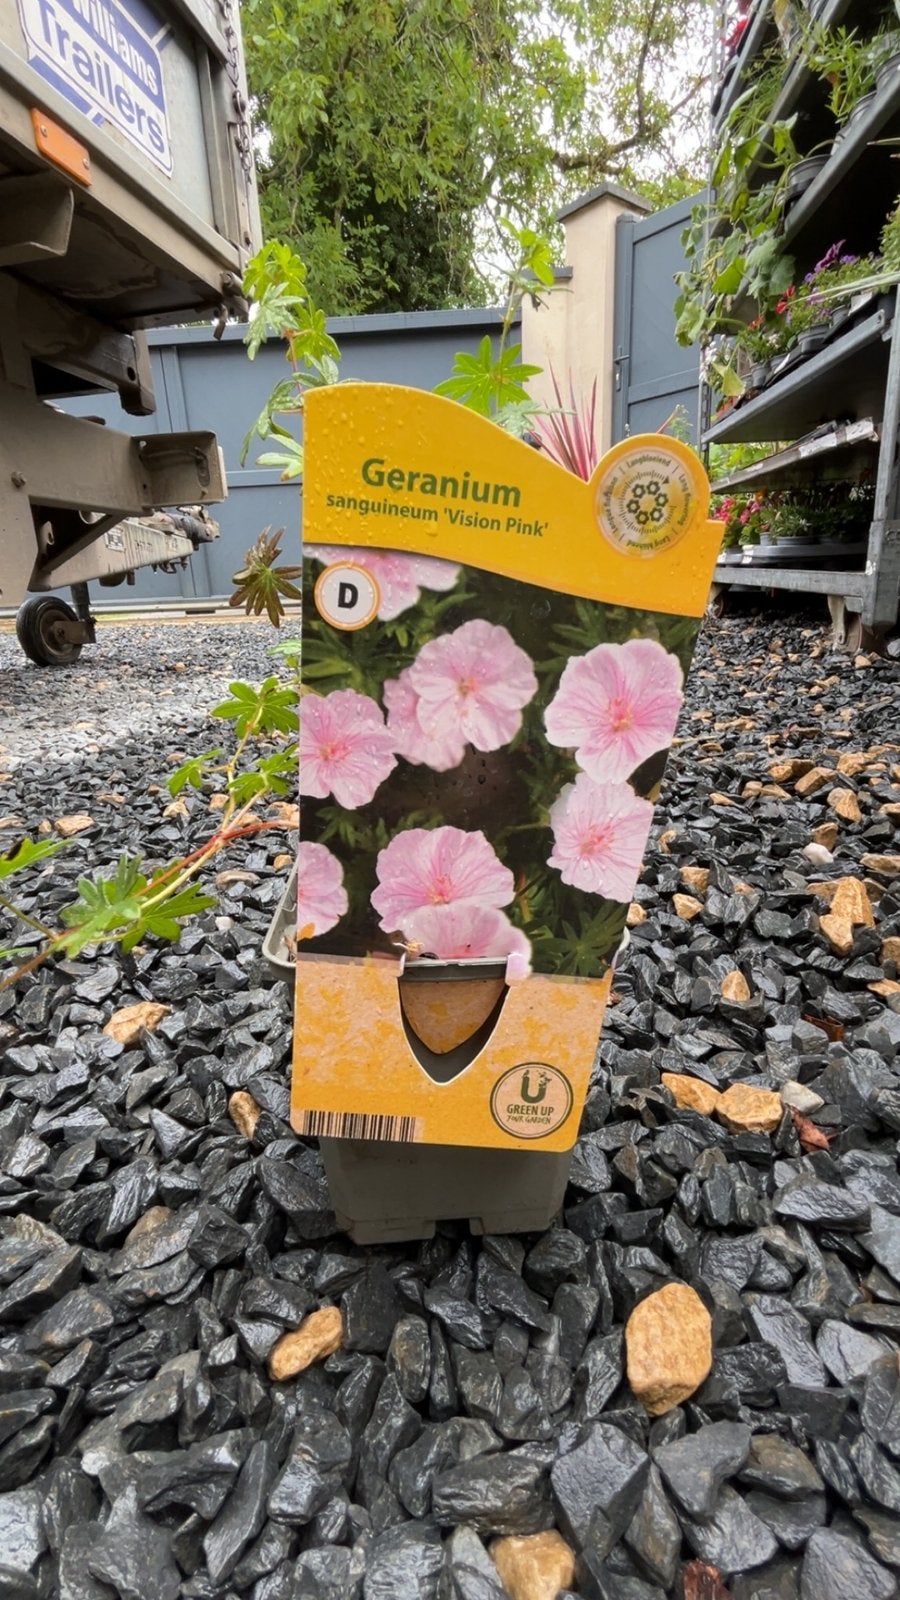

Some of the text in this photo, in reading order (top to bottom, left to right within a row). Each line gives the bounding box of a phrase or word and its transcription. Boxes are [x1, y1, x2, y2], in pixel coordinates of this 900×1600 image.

[37, 0, 165, 154] Trailers
[361, 457, 522, 508] Geranium
[326, 494, 549, 537] sanguineum 'Vision Pink'
[337, 581, 360, 609] D
[506, 1104, 555, 1117] GREEN UP
